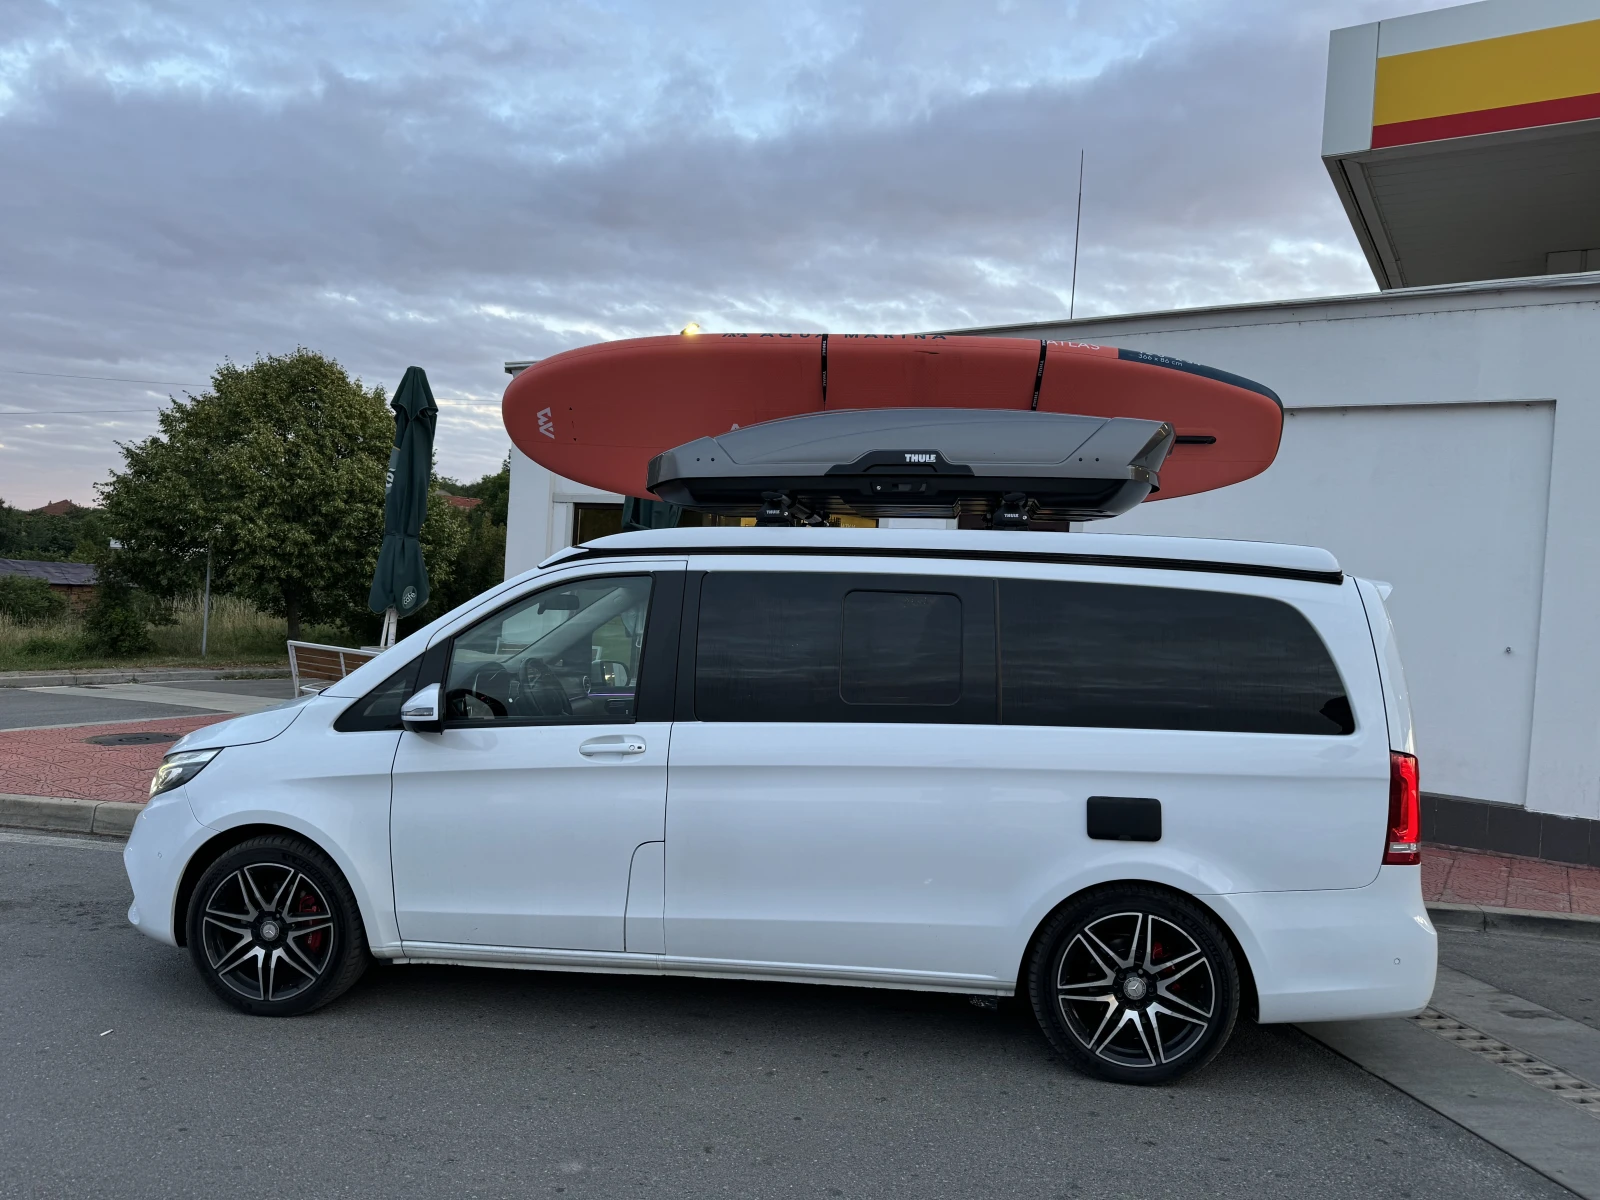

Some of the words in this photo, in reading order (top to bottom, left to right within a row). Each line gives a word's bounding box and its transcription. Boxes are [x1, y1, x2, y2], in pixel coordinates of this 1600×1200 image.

[1047, 339, 1100, 351] ATLAS
[1138, 353, 1153, 361] 366
[904, 453, 937, 463] THULE
